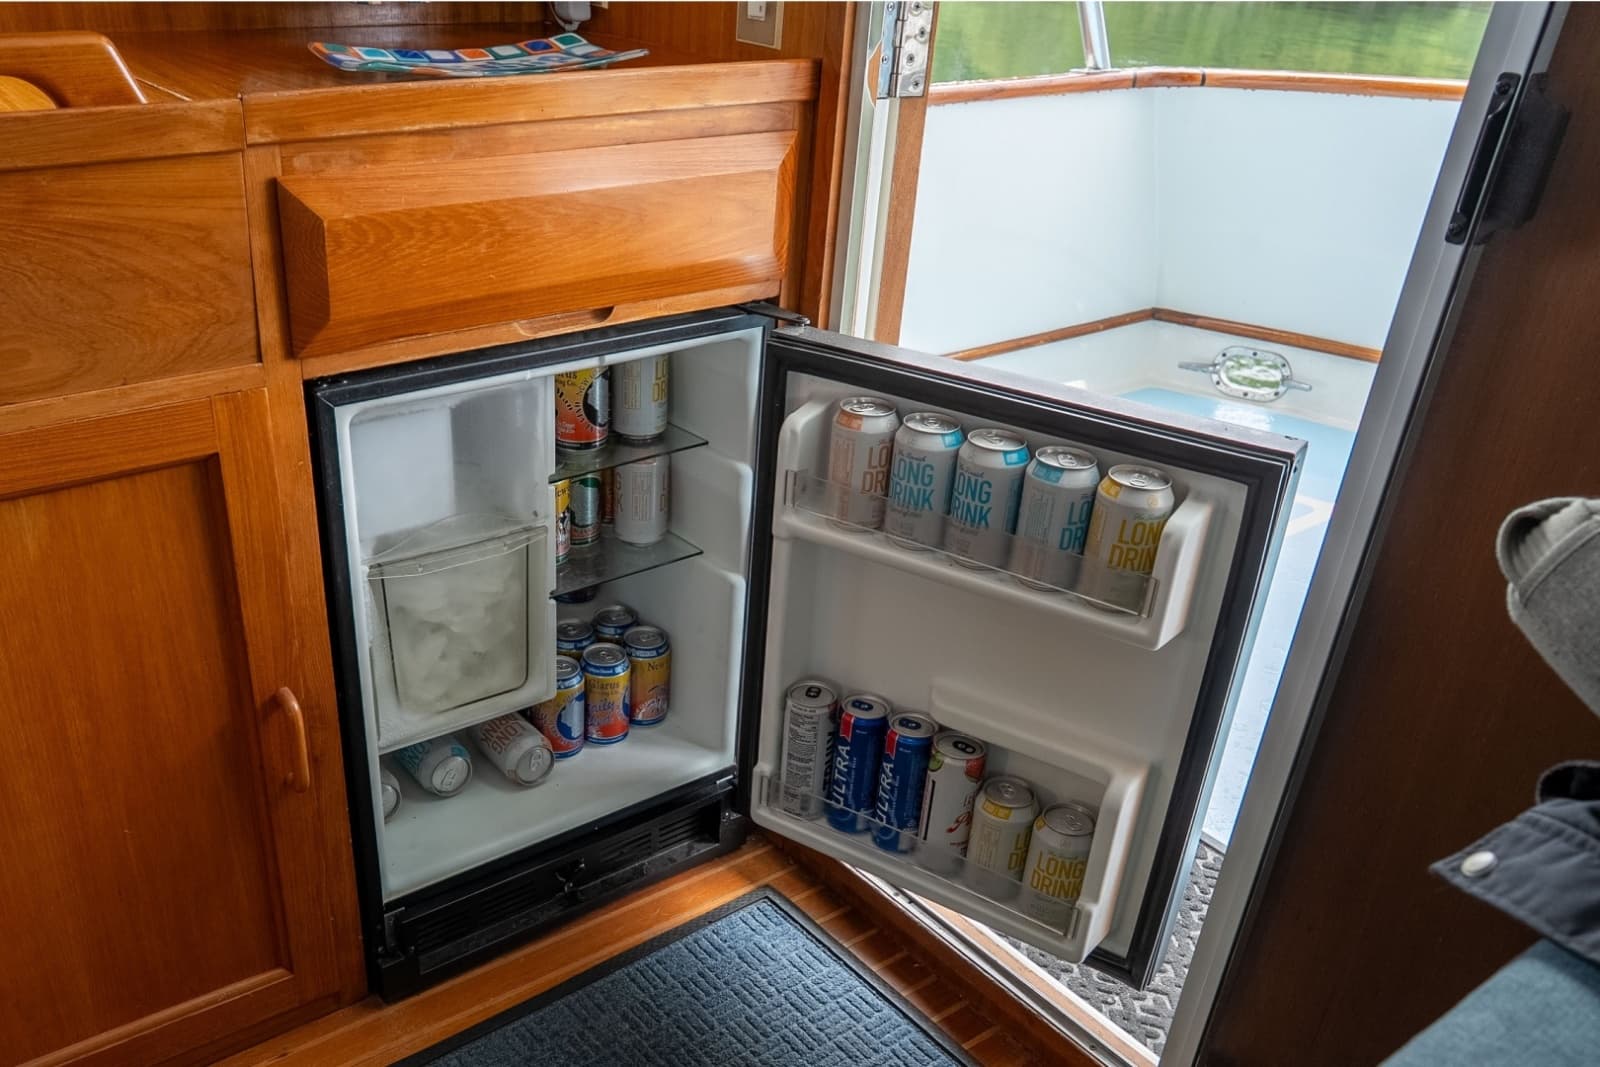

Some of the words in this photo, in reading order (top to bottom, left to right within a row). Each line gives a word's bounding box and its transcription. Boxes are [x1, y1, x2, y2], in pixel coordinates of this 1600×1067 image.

[868, 445, 890, 469] LO
[892, 457, 934, 487] LONG
[862, 471, 887, 493] DR
[890, 477, 934, 511] DRINK
[953, 472, 992, 505] ONG
[952, 495, 992, 529] RINK
[1068, 500, 1093, 526] LO
[1059, 526, 1086, 554] DR
[1108, 544, 1157, 572] DRIN
[832, 745, 850, 808] ULTRA
[875, 762, 894, 825] ULTRA
[1037, 850, 1085, 880] LONG
